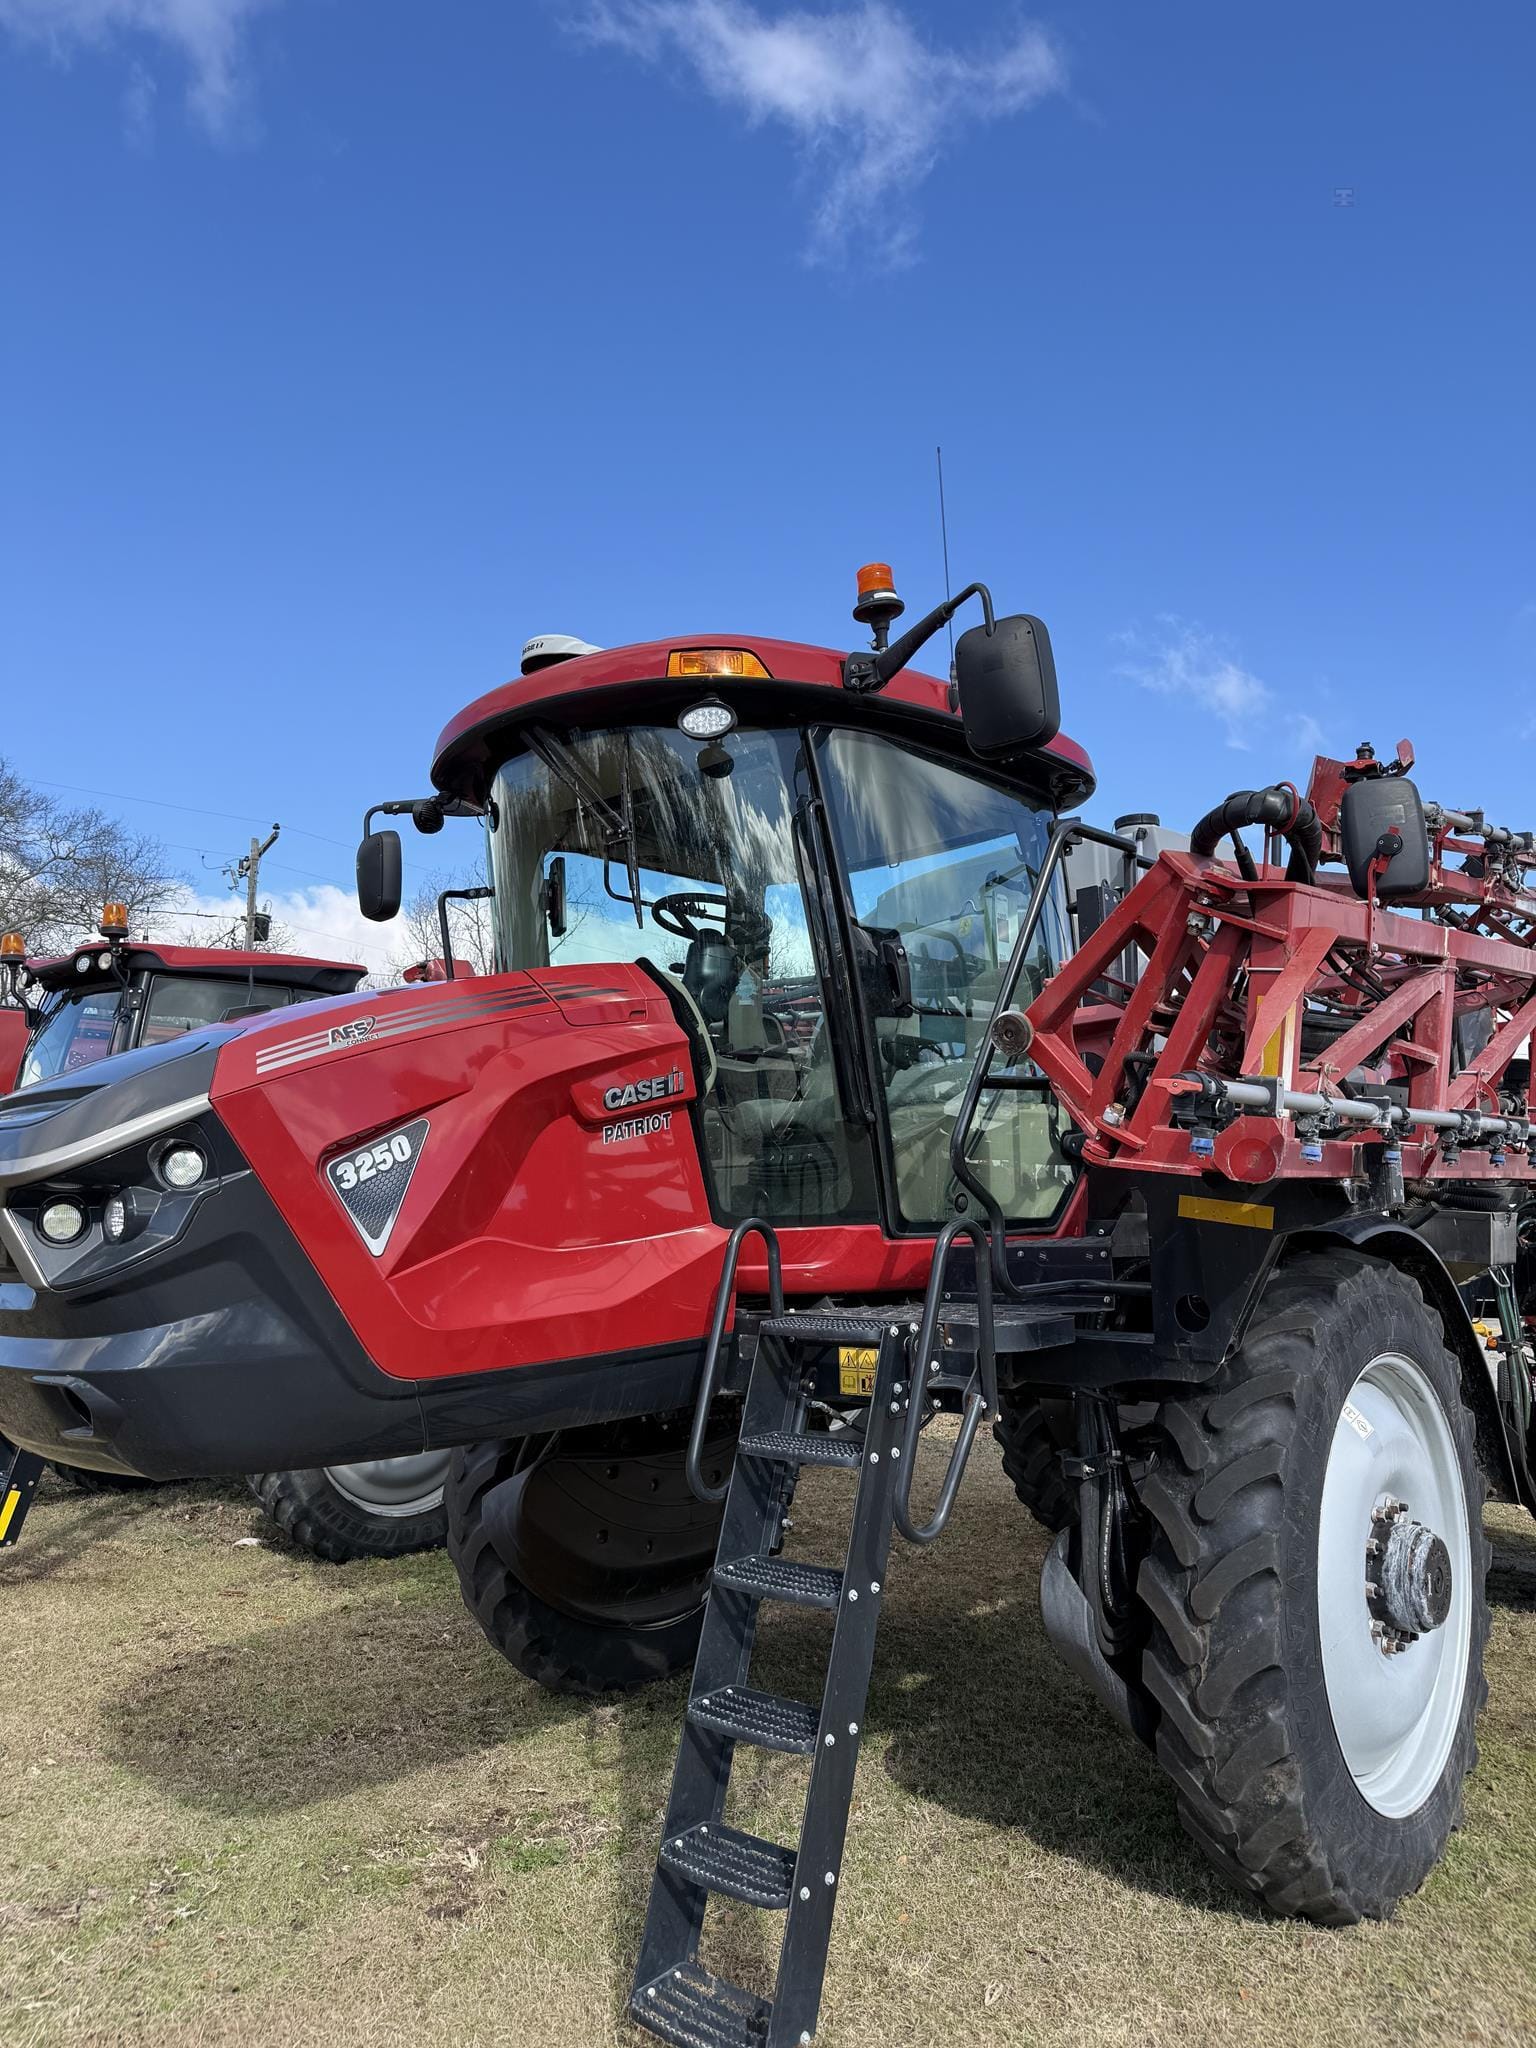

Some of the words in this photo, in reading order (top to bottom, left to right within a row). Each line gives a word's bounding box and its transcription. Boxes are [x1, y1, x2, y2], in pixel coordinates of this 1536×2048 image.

[329, 1020, 370, 1044] AFS
[604, 1076, 665, 1110] CASE
[603, 1111, 672, 1145] PATRIOT
[336, 1135, 412, 1190] 3250
